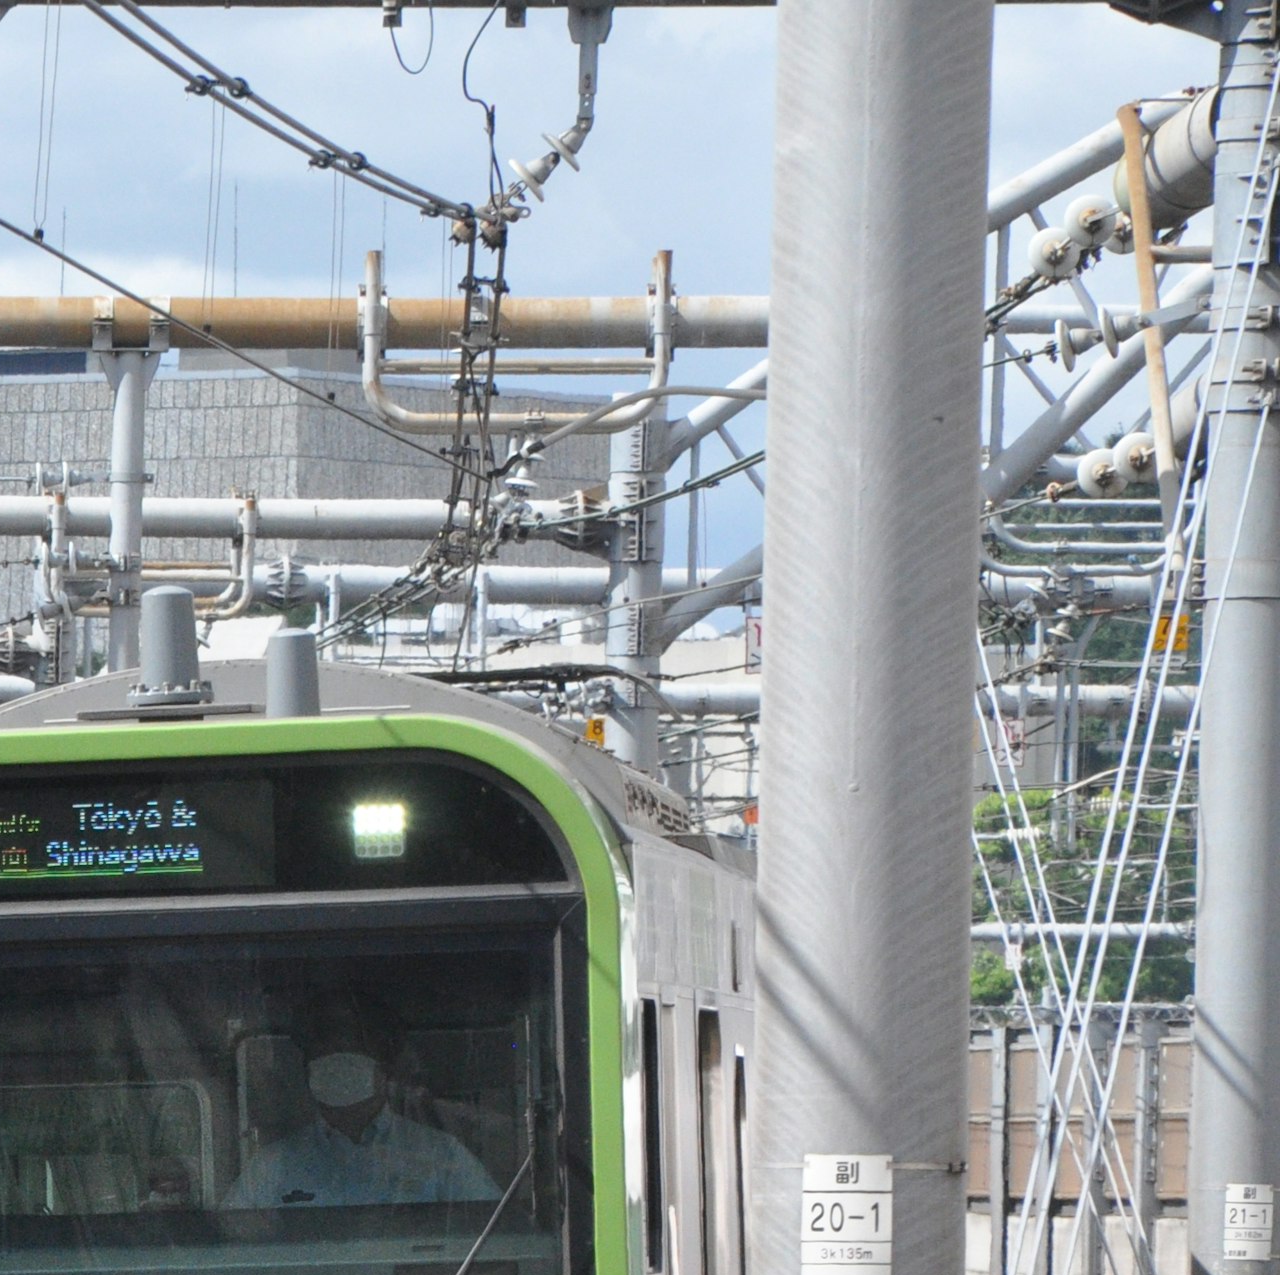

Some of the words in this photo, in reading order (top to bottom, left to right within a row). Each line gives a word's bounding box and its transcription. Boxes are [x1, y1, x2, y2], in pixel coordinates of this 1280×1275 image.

[172, 800, 198, 828] &
[46, 841, 200, 873] Shinagawa
[836, 1161, 860, 1184] 副
[811, 1202, 880, 1233] 20-1
[1229, 1208, 1267, 1224] 21-1
